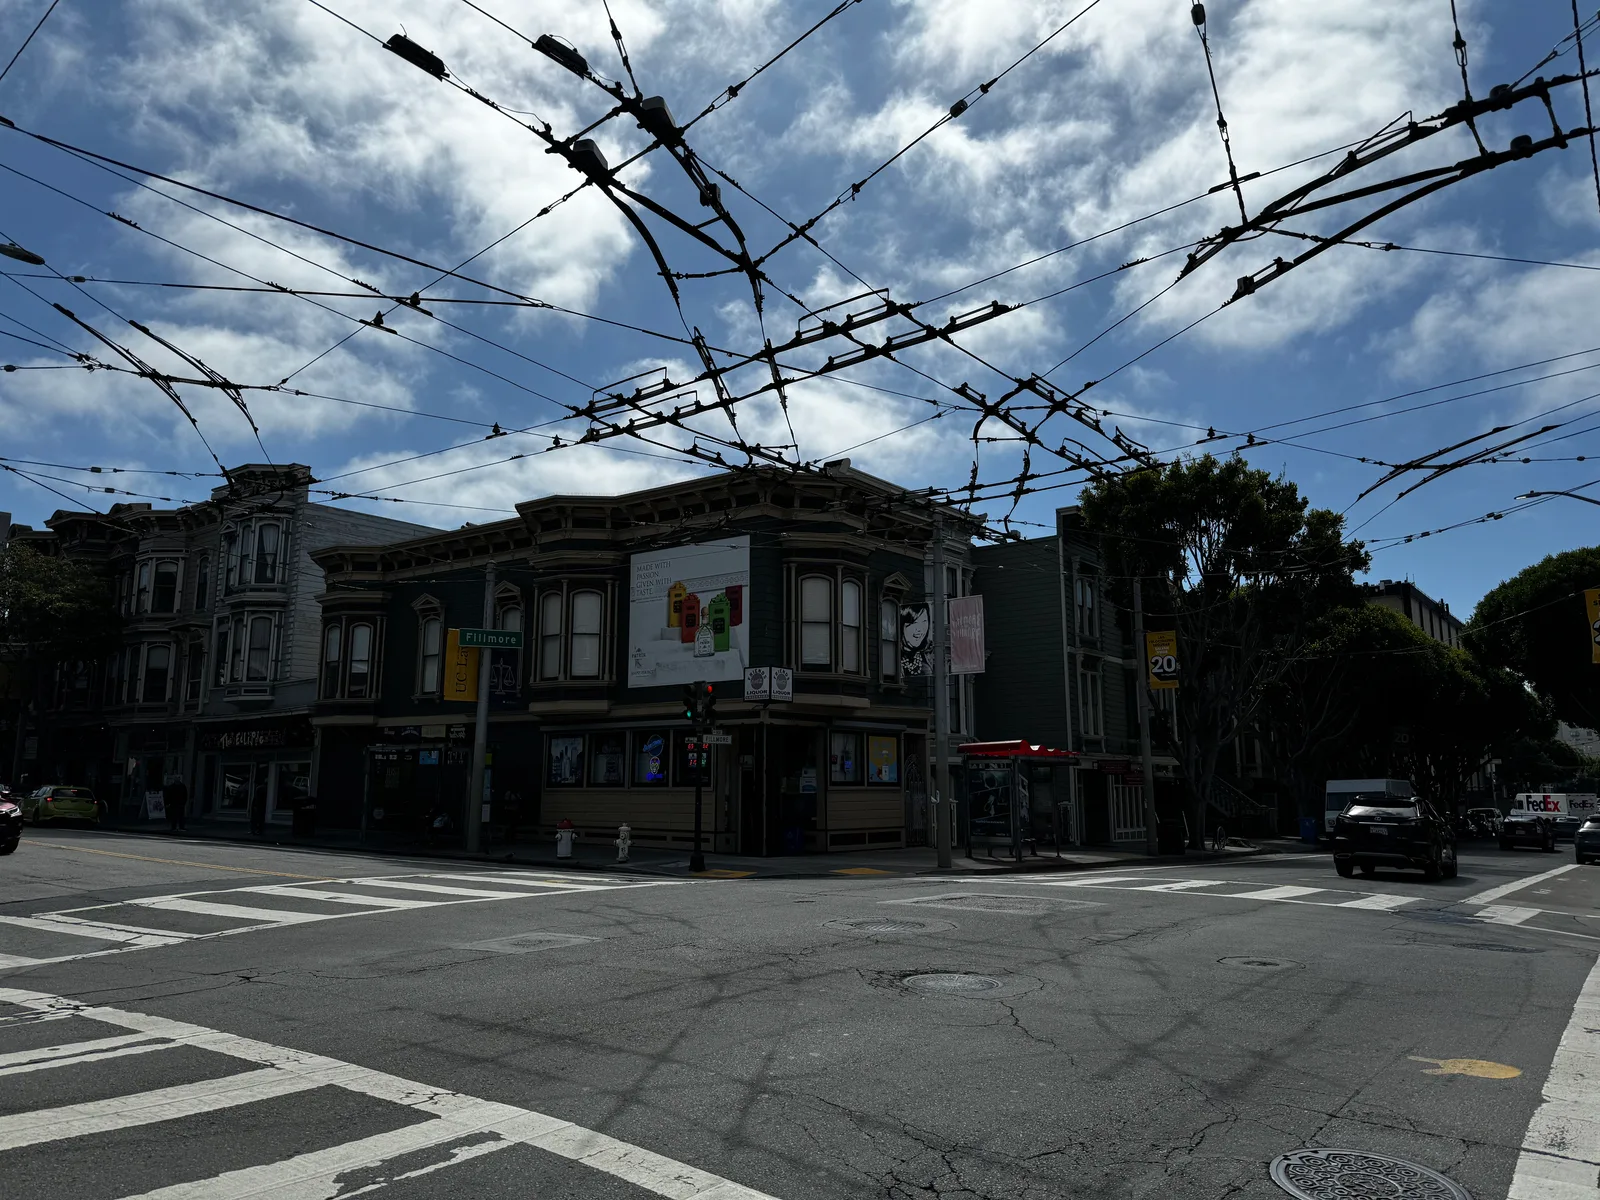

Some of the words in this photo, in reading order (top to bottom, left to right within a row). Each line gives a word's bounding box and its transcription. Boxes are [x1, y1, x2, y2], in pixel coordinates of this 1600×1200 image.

[637, 563, 654, 572] MADE
[655, 561, 671, 569] WITH
[656, 578, 672, 586] WITH
[466, 632, 517, 644] Fillmore
[1151, 655, 1176, 673] 20
[747, 669, 767, 681] FRIENDS
[456, 673, 468, 693] UC
[705, 735, 729, 743] FILLMORE
[1394, 732, 1410, 744] 20
[1526, 795, 1561, 812] FedEx
[1569, 800, 1595, 810] FedEx
